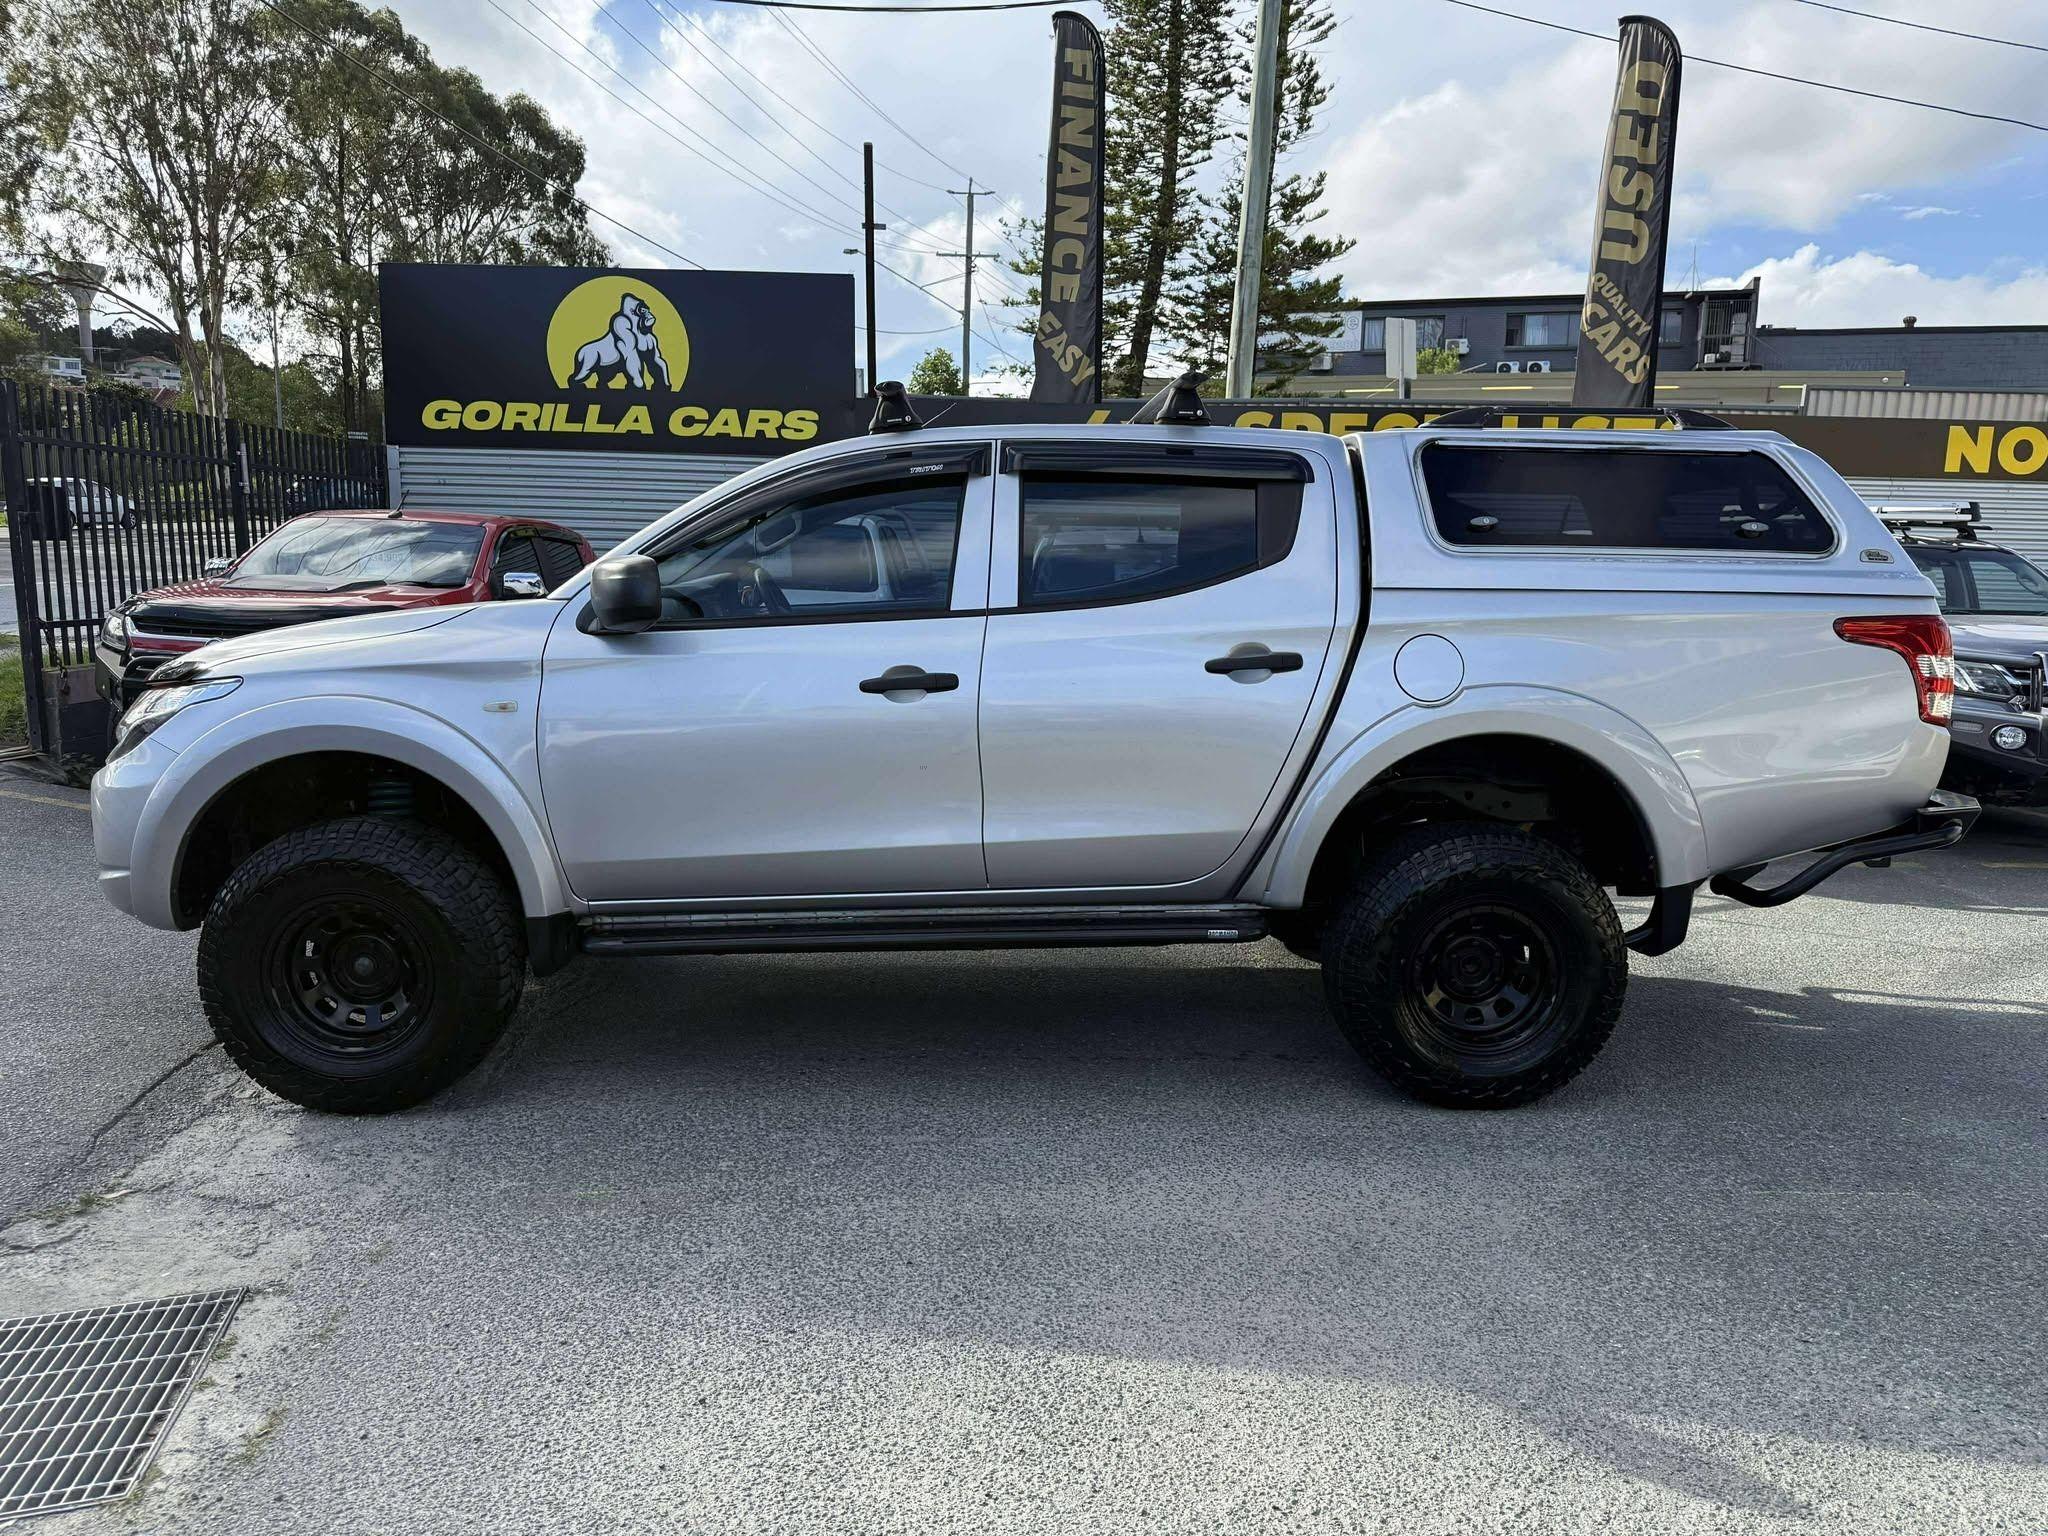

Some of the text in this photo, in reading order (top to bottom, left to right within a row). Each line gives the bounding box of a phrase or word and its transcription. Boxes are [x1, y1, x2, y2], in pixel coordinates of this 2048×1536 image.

[1050, 48, 1096, 303] FINANCE
[1600, 60, 1666, 265] USED
[1580, 302, 1651, 385] CARS
[1592, 272, 1651, 337] QUALITY
[1038, 311, 1096, 386] EASY
[421, 400, 820, 440] GORILLA CARS
